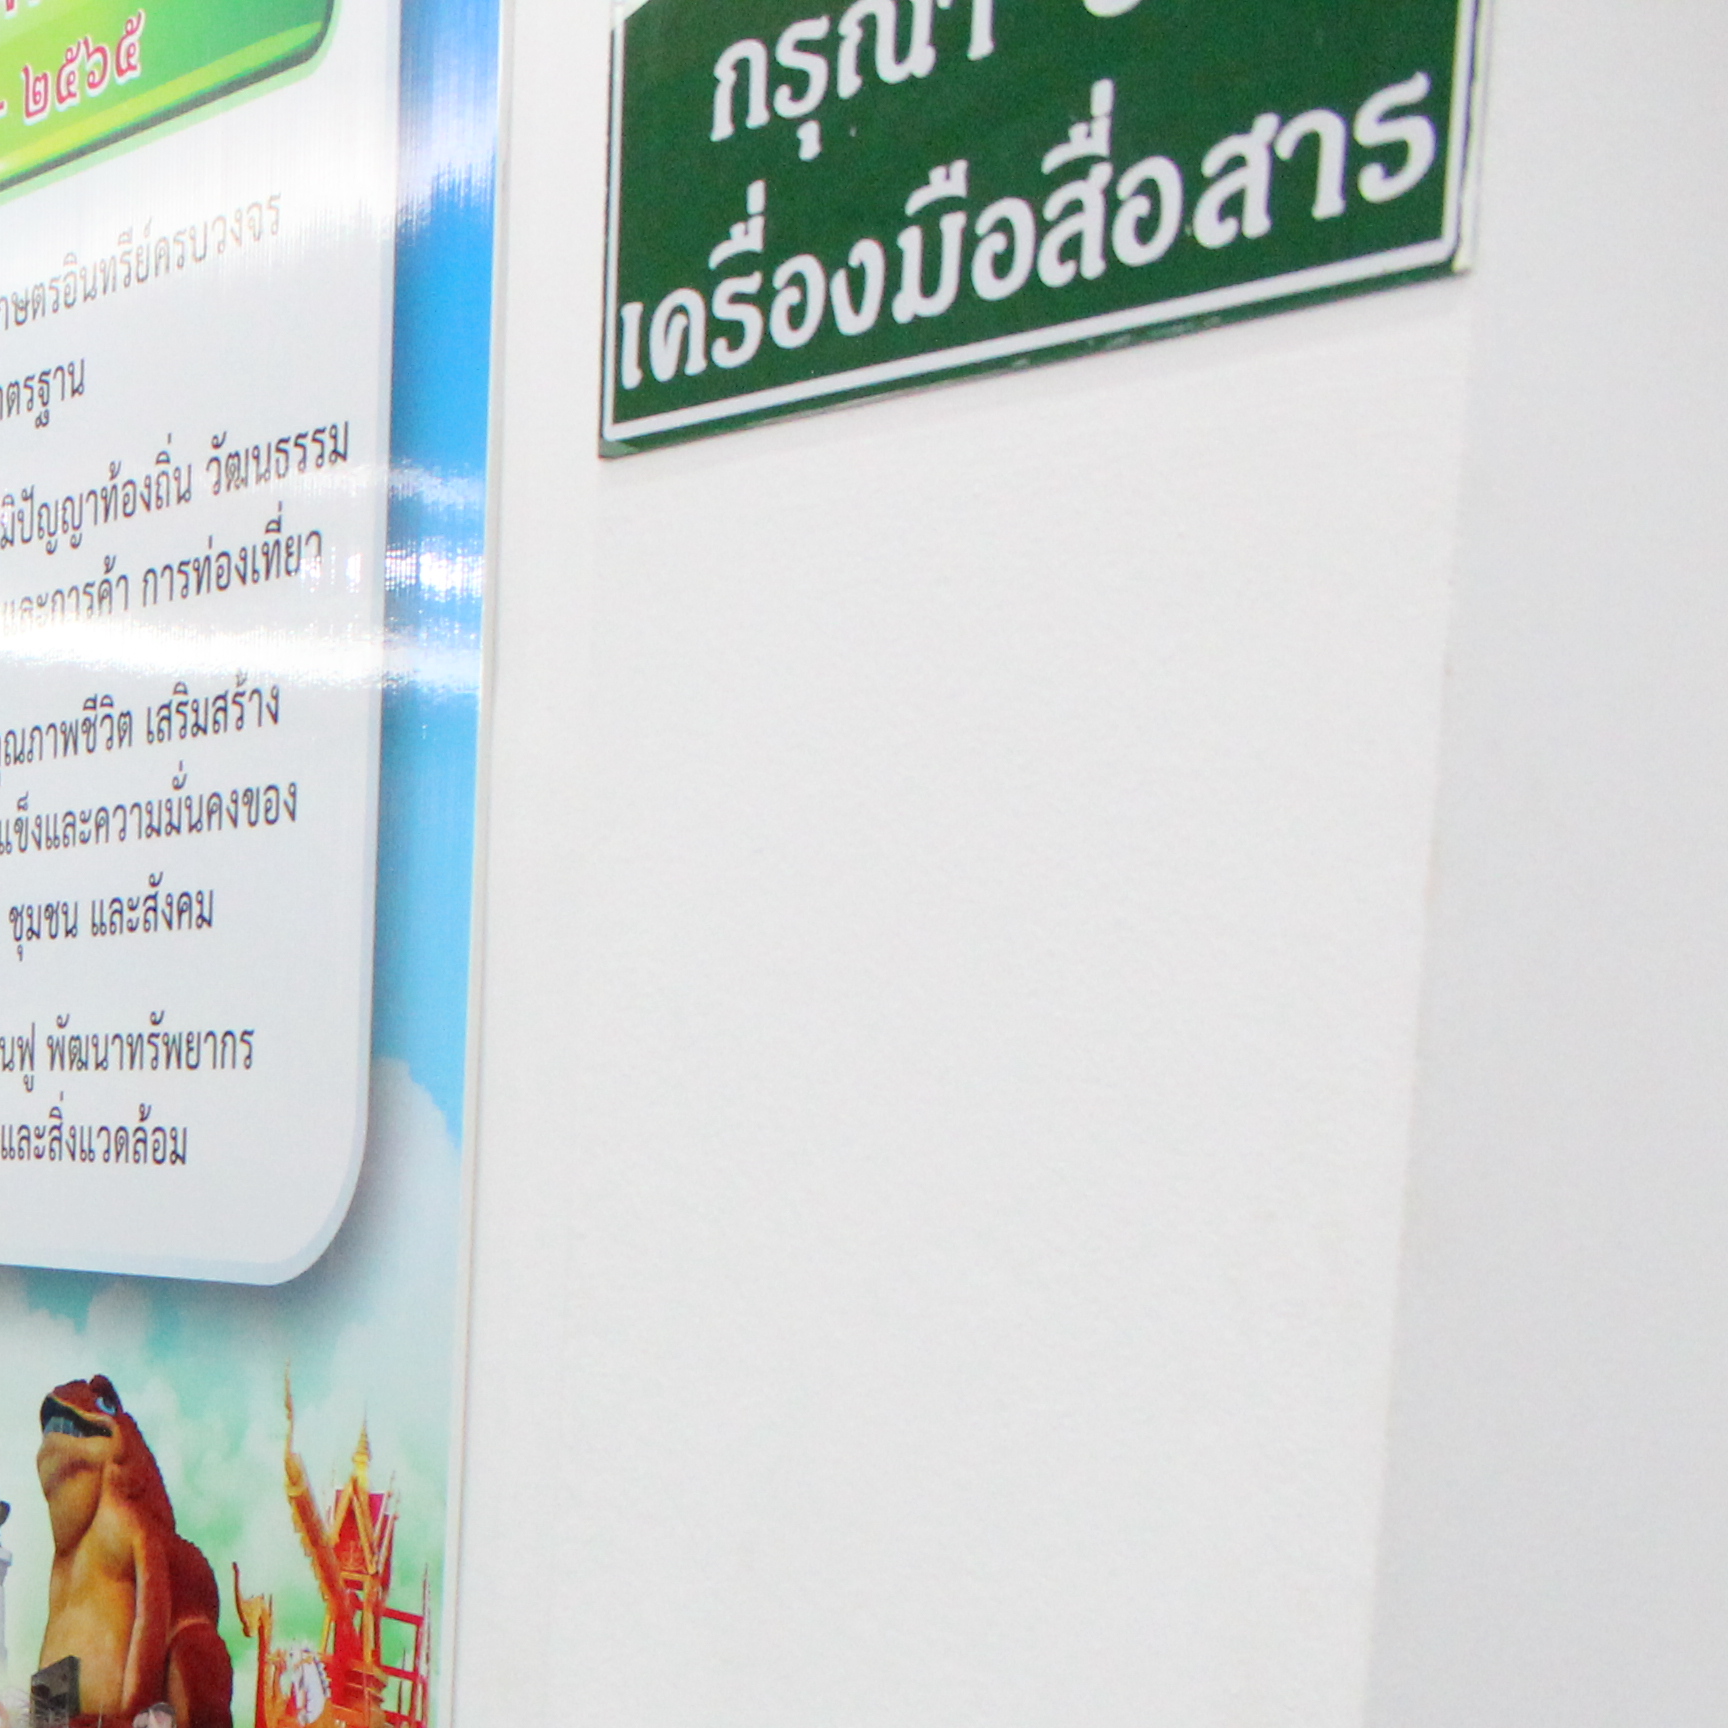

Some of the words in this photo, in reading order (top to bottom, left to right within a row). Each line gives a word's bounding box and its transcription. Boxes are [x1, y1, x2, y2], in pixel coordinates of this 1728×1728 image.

[21, 9, 145, 121] ๒๕๖๕
[620, 72, 1437, 389] เครื่องมือสื่อสาร
[206, 420, 350, 495] วัฒนธรรม
[143, 501, 323, 608] การท่องเที่ยว
[146, 670, 280, 744] เสริมสร้าง
[9, 897, 79, 961] ชุมชน
[91, 871, 215, 940] และสังคม
[46, 1010, 255, 1073] พัฒนาทรัพยากร
[0, 1091, 189, 1166] และสิ่งแวดล้อม
